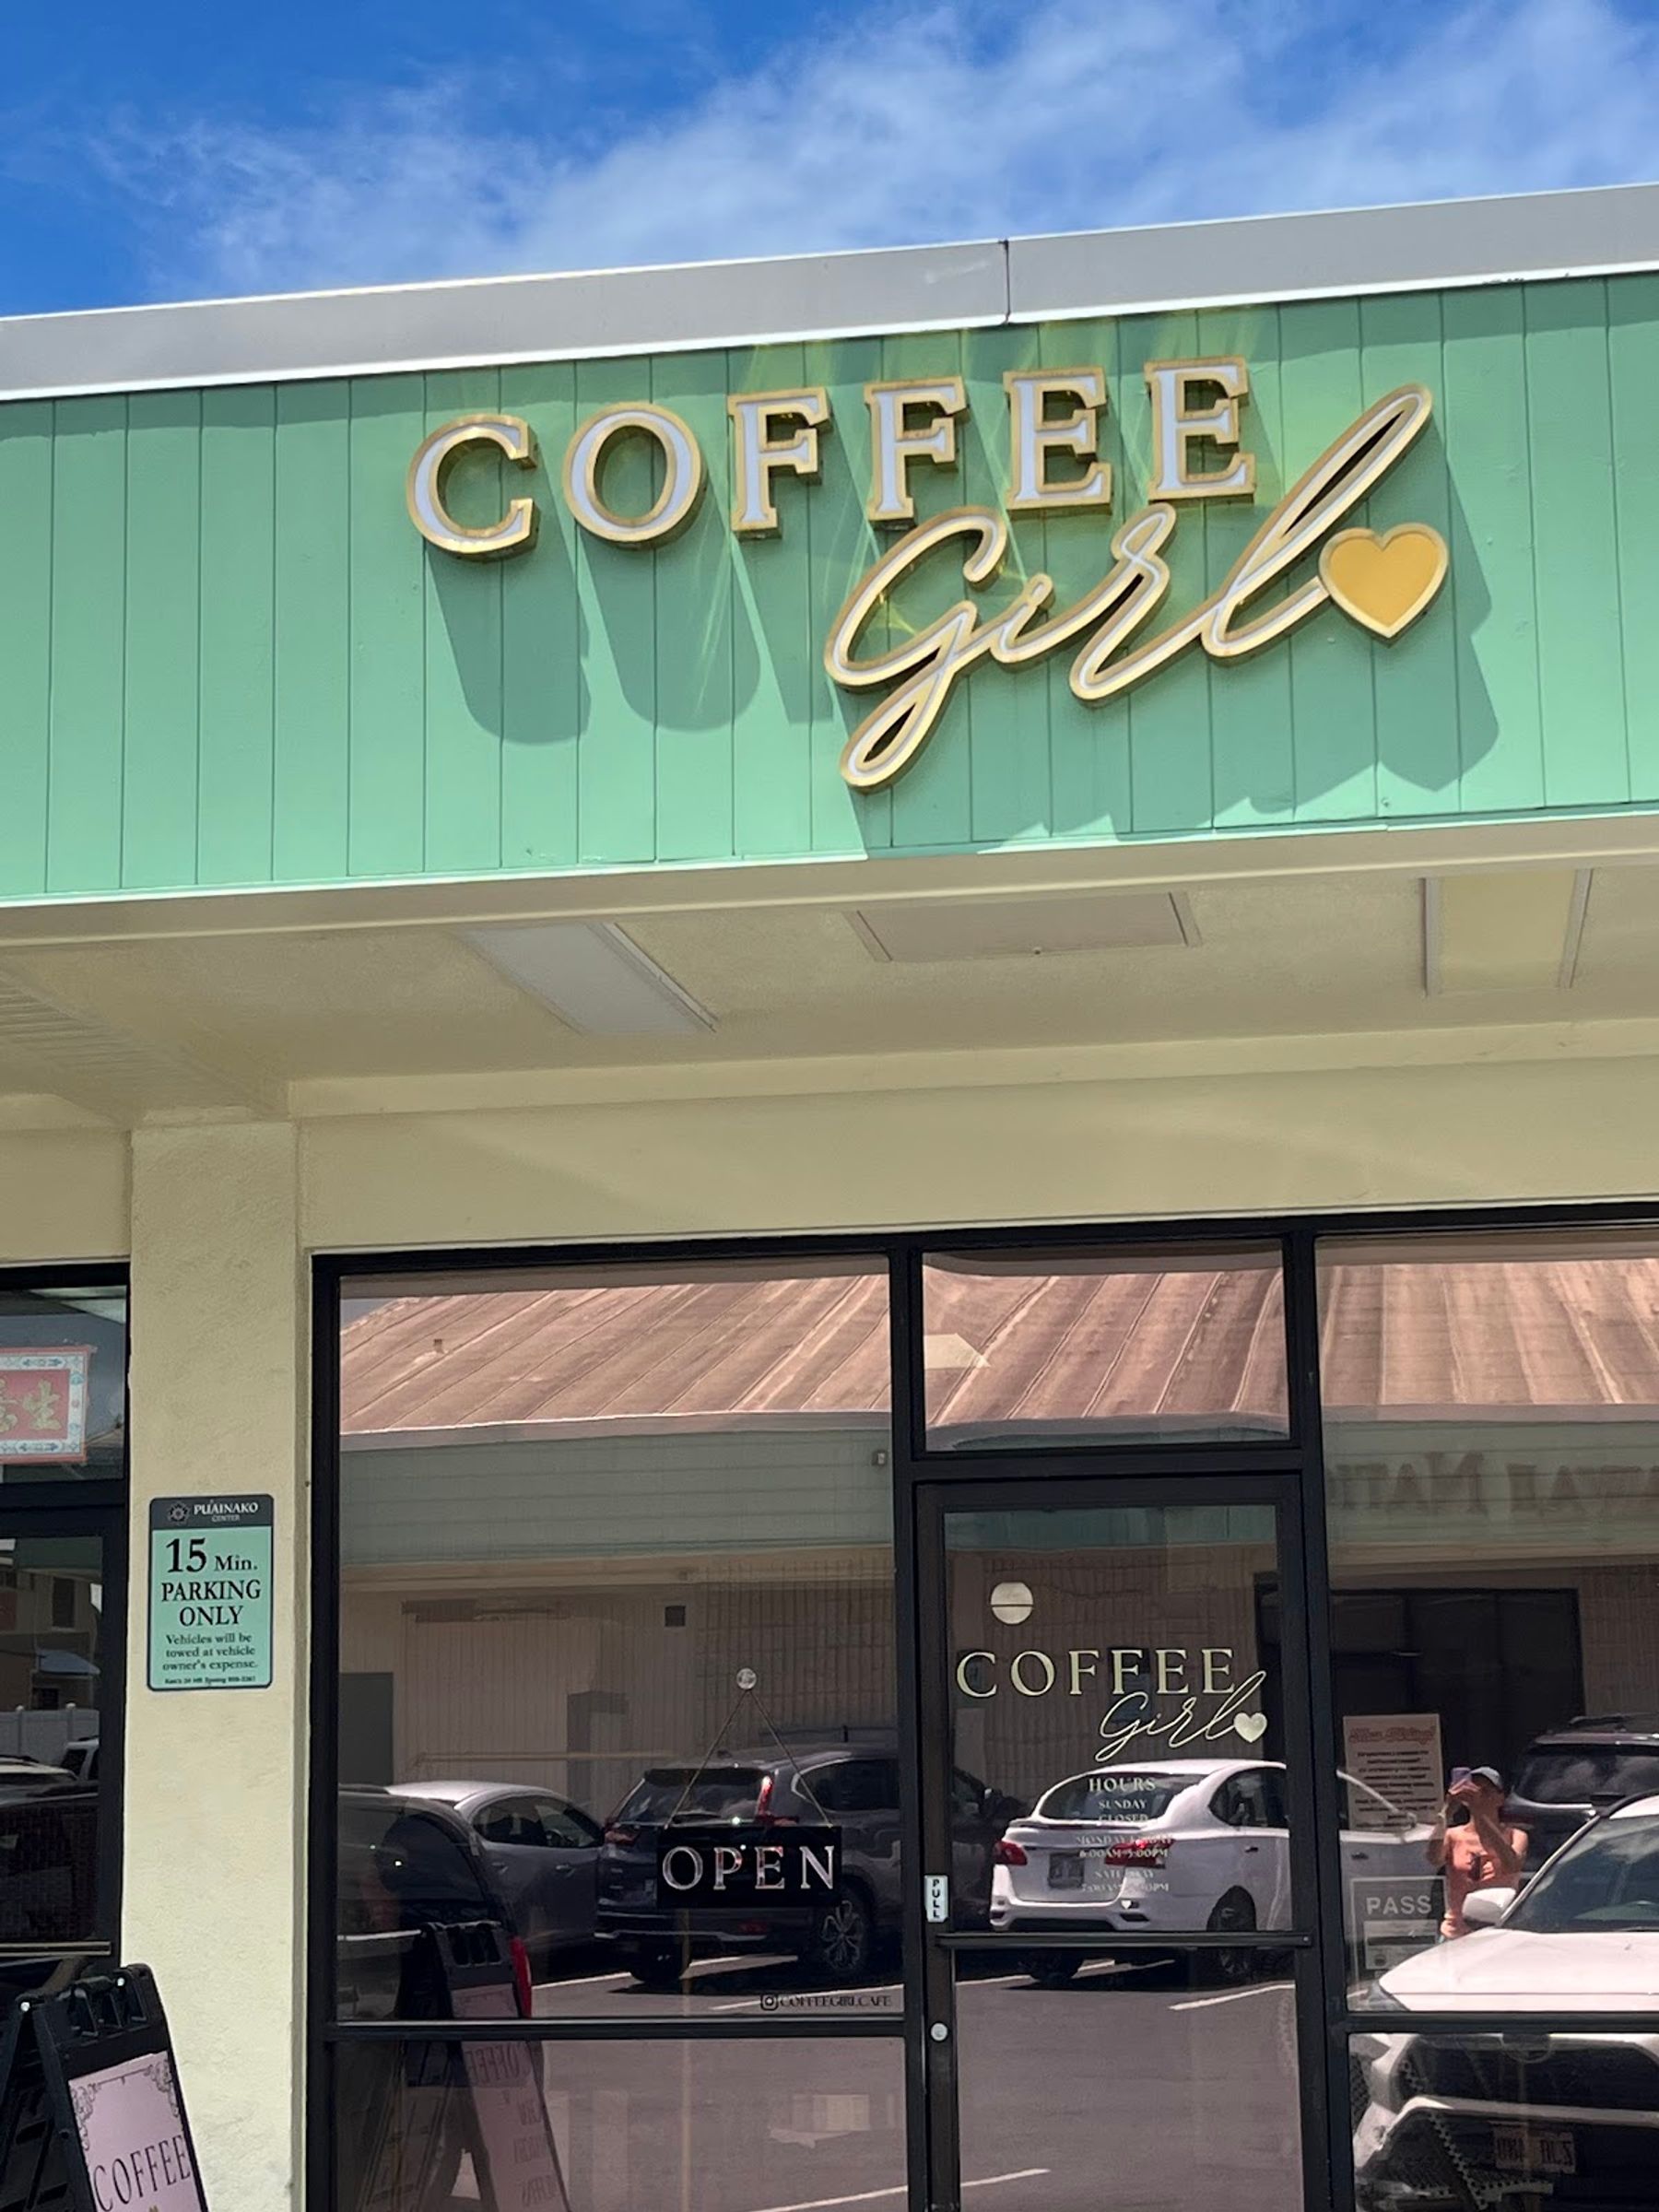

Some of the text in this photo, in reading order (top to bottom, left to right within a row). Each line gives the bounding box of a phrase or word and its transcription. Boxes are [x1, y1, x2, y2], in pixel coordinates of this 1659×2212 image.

[406, 357, 1256, 562] COFFEE
[824, 382, 1434, 793] Girl
[166, 1537, 258, 1572] 15 Min.
[161, 1579, 261, 1602] PARKING
[180, 1606, 243, 1627] ONLY
[166, 1632, 253, 1644] Vehicles will be
[166, 1647, 199, 1657] towed
[216, 1645, 256, 1656] vehicle
[162, 1659, 258, 1672] owner's expense.
[957, 1648, 1236, 1698] COFFEE
[1095, 1670, 1266, 1761] Girl
[1088, 1777, 1157, 1792] HOURS
[1099, 1799, 1147, 1809] SUNDAY
[1099, 1814, 1149, 1823] CLOSED
[662, 1845, 835, 1889] OPEN
[932, 1878, 941, 1918] PULL
[1366, 1896, 1431, 1914] PASS
[93, 2134, 191, 2212] COFFEE
